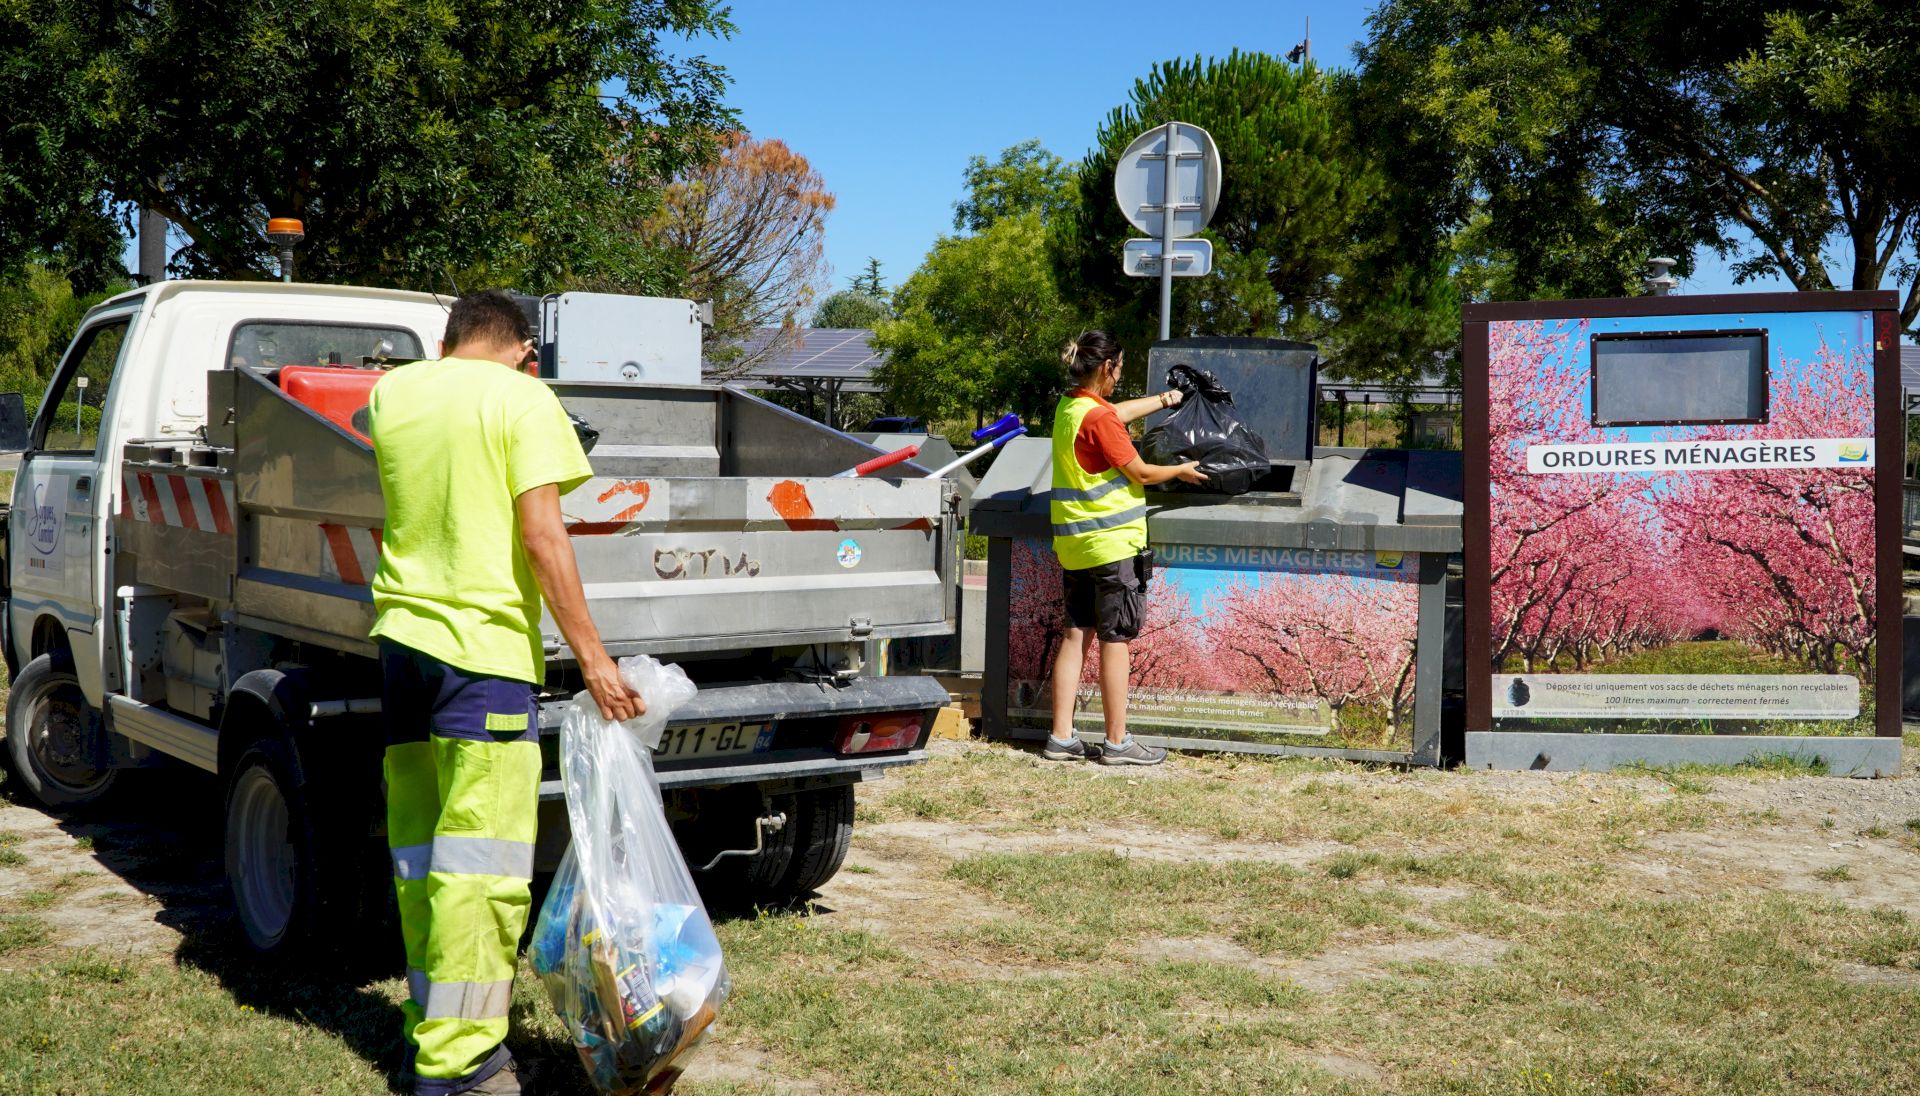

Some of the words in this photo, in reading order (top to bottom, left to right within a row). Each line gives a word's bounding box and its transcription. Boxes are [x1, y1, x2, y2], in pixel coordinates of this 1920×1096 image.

[1542, 448, 1656, 468] ORDURES
[1664, 442, 1816, 465] MÉNAGÈRES
[1546, 682, 1581, 693] Déposez
[1583, 682, 1593, 691] ici
[1595, 683, 1647, 693] uniquement
[1686, 683, 1698, 691] de
[1700, 682, 1735, 692] déchets
[1736, 682, 1779, 693] ménagers
[1800, 682, 1849, 692] recyclables
[1605, 697, 1621, 705] 100
[1623, 696, 1645, 705] litres
[1647, 696, 1690, 705] maximum
[1697, 697, 1757, 705] correctement
[1758, 696, 1790, 705] fermés
[756, 735, 771, 749] 84
